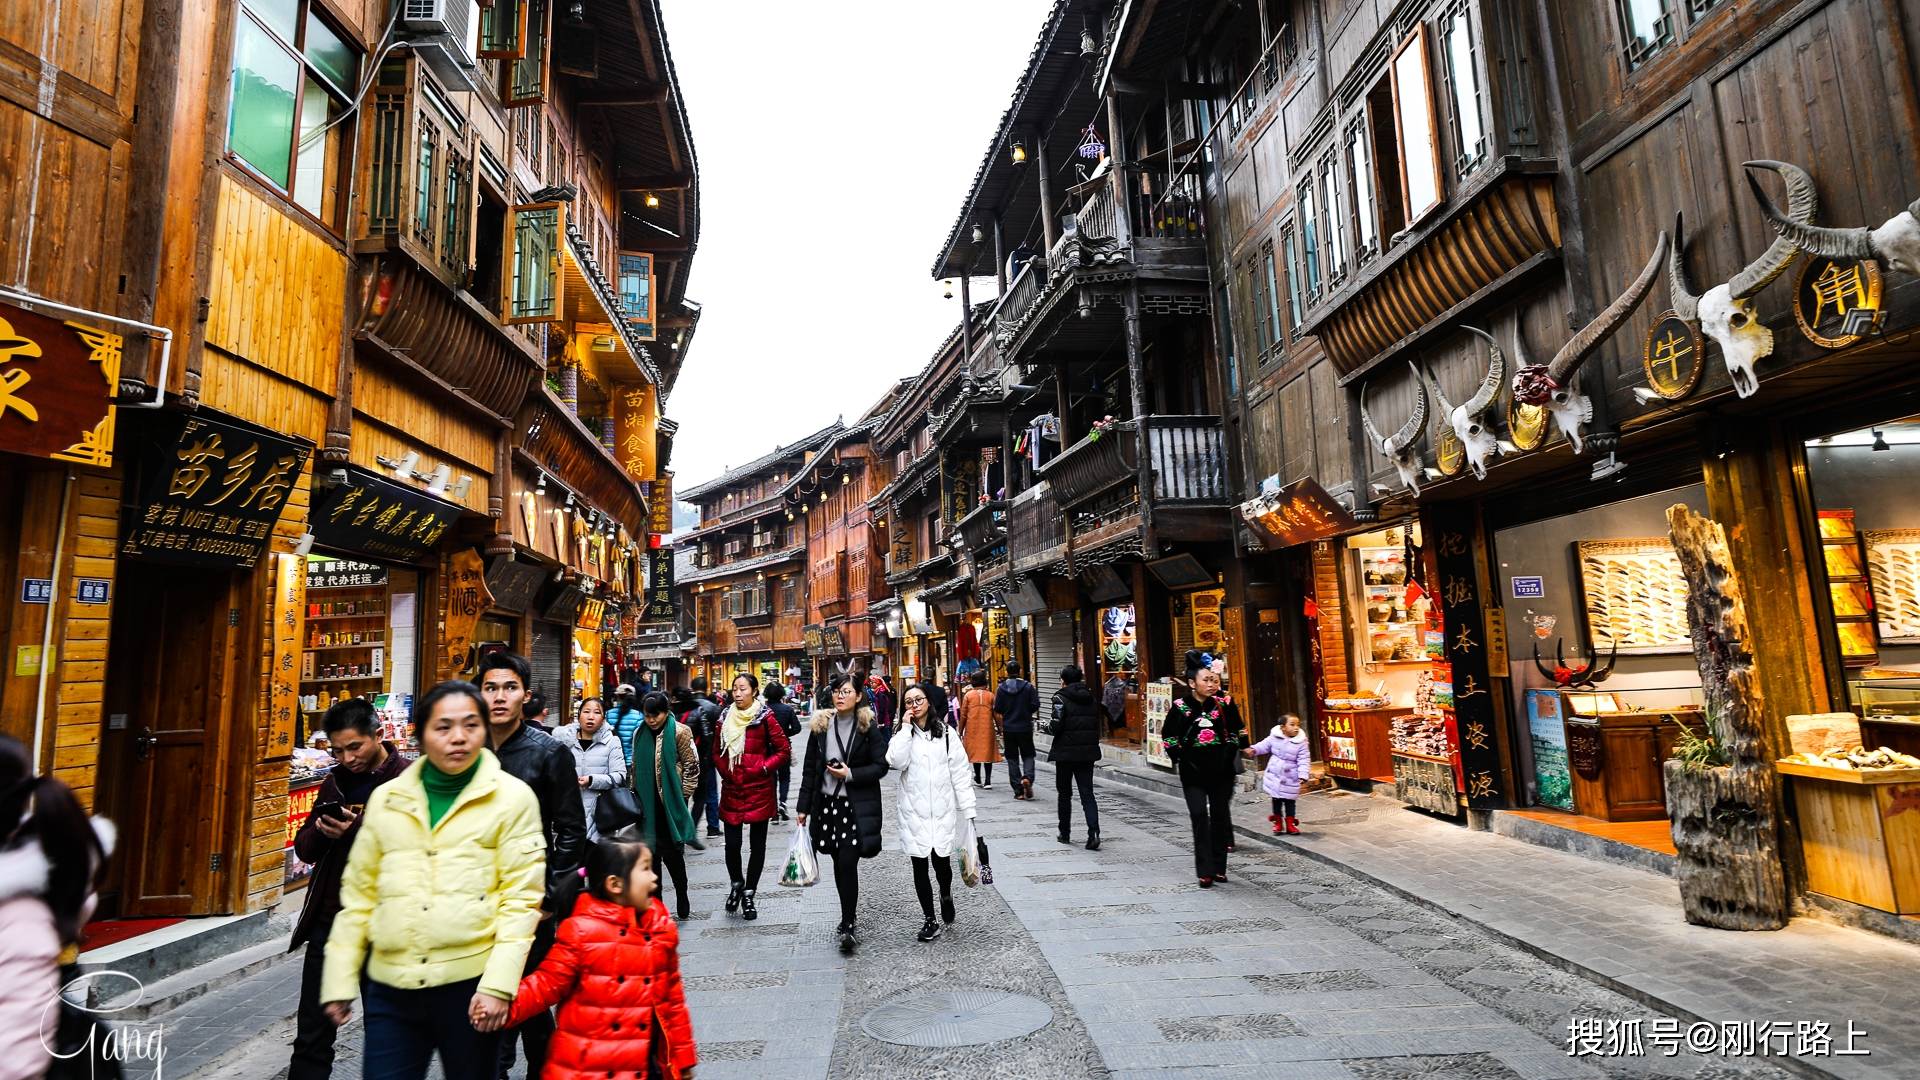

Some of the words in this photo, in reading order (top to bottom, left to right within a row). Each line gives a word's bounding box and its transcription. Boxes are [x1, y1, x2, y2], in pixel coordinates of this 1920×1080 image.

[1811, 261, 1867, 329] 角
[1651, 329, 1693, 381] 牛
[622, 388, 648, 477] 苗湘食府
[168, 433, 296, 511] 苗乡居
[143, 502, 181, 527] 客栈
[212, 515, 243, 536] 热水
[240, 520, 272, 540] 空调
[327, 574, 372, 586] 代办托运
[655, 548, 670, 603] 兄弟主题
[651, 604, 673, 616] 酒店
[1439, 530, 1500, 799] 挖掘本土资源
